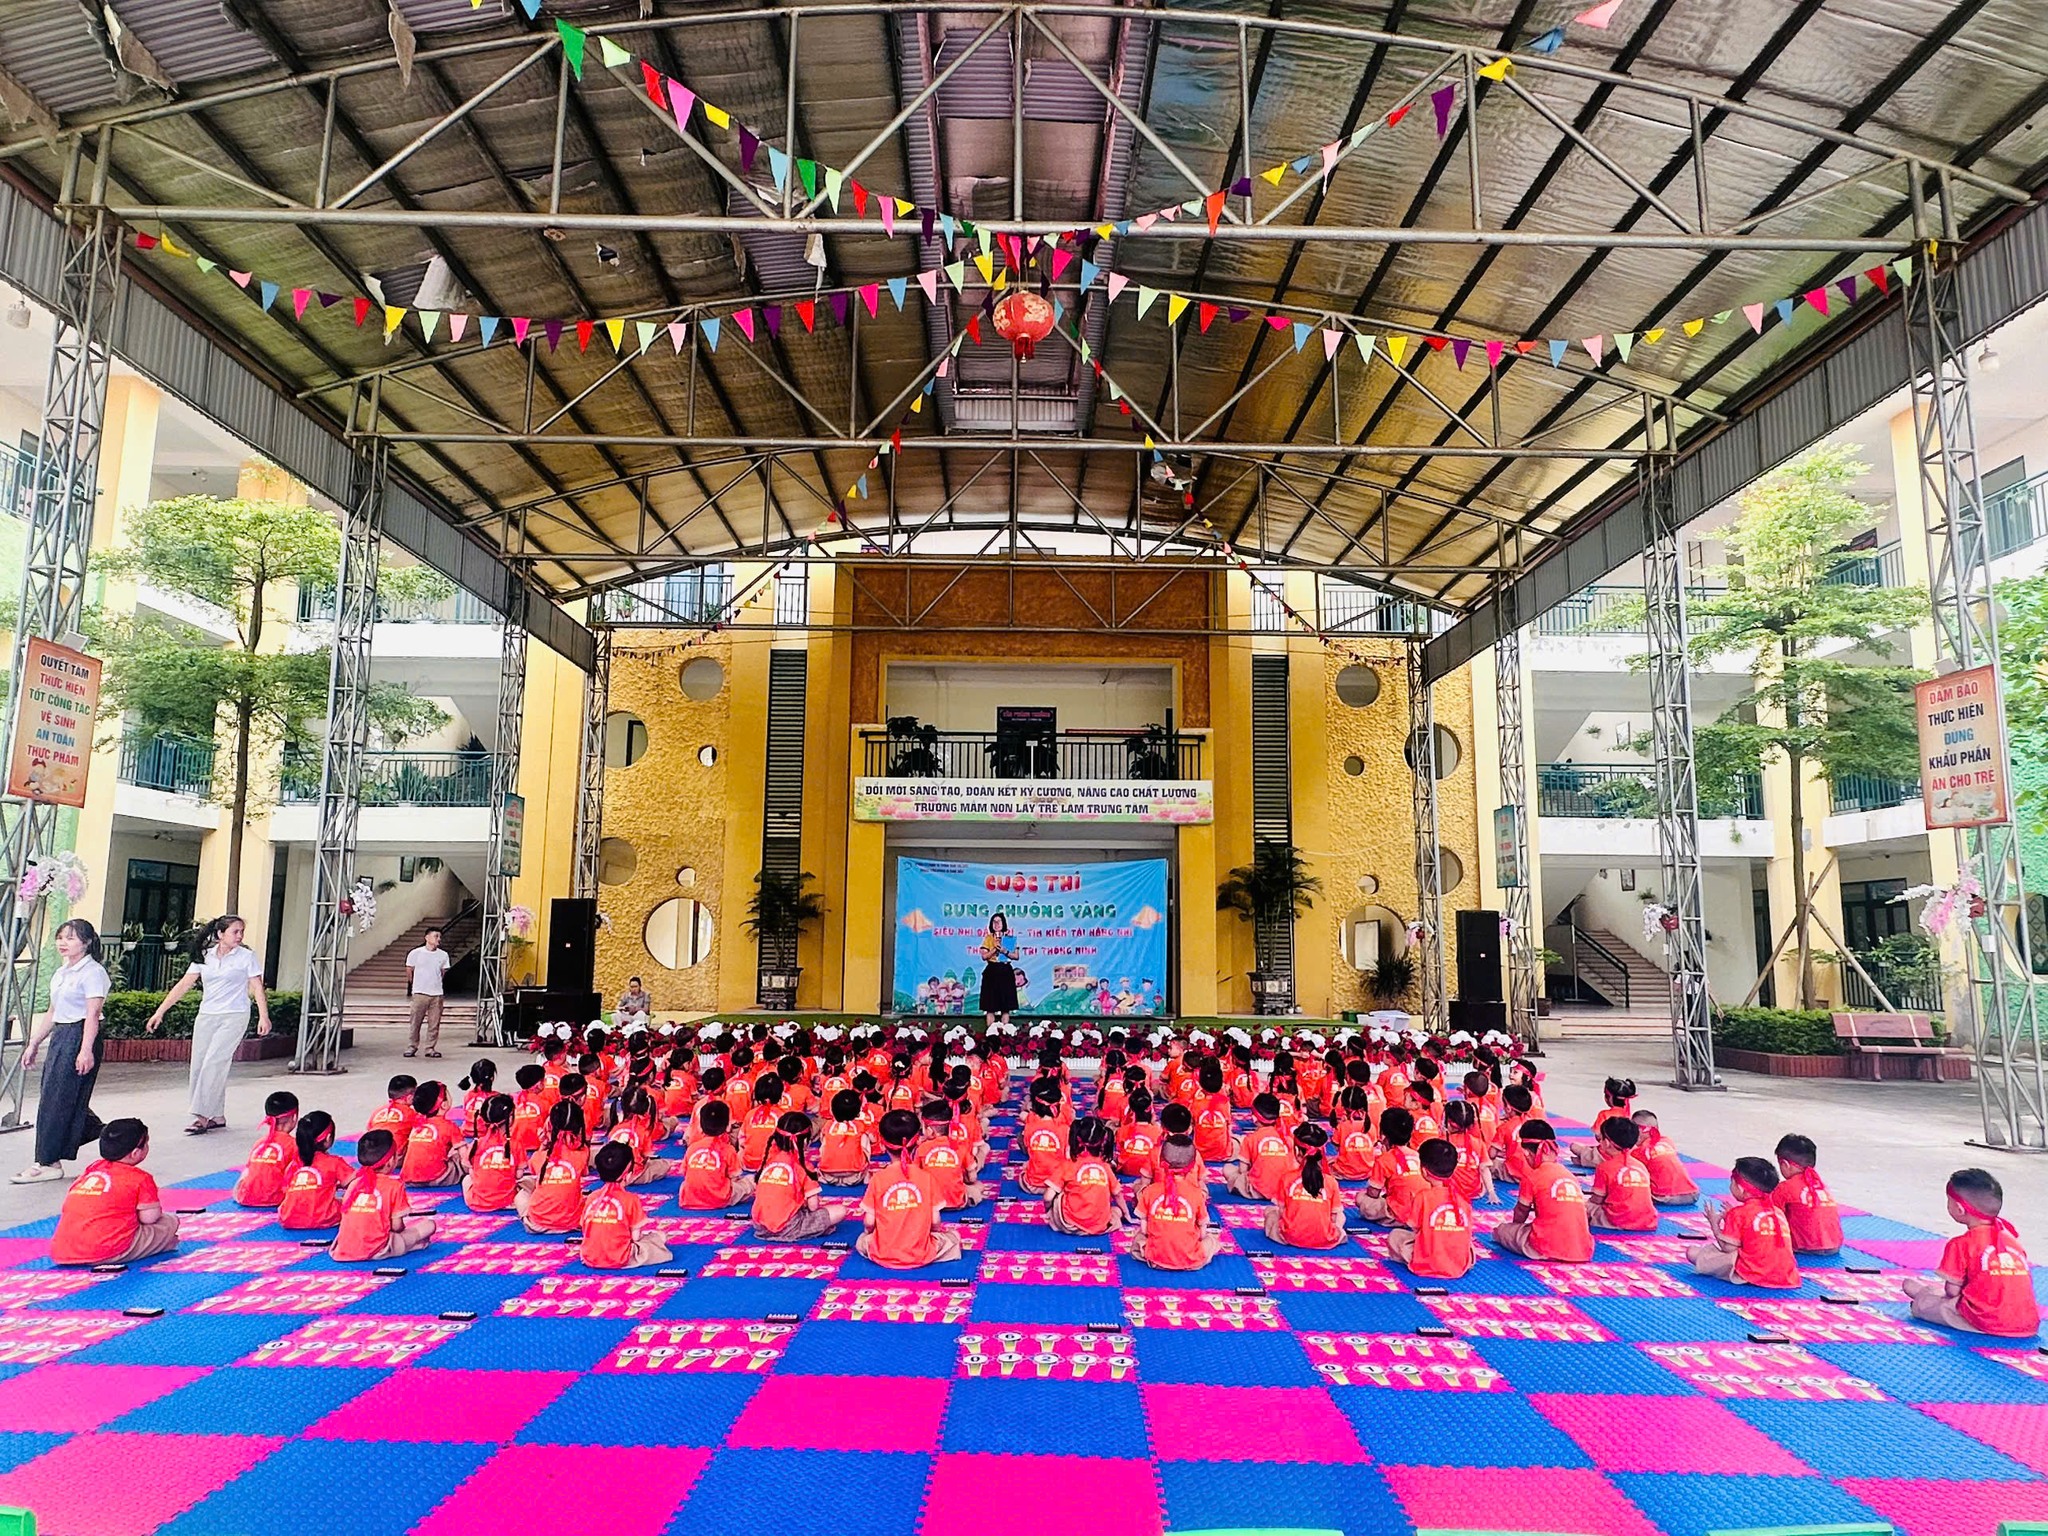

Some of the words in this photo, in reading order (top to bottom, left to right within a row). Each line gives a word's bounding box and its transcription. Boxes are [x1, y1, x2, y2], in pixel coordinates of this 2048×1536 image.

[41, 654, 69, 672] QUYẾT
[72, 664, 89, 680] TÂM
[29, 688, 46, 702] TỐT
[48, 694, 72, 710] CÔNG
[41, 710, 52, 726] VỆ
[54, 715, 76, 729] SINH
[1928, 710, 1954, 726] THỰC
[1958, 702, 1984, 720] HIỆN
[36, 728, 49, 740] AN
[1929, 749, 1957, 769] KHẨU
[1950, 773, 1971, 788] CHO
[1110, 788, 1129, 798] CAO
[990, 803, 1012, 813] NON
[1087, 804, 1122, 813] TRUNG
[986, 871, 1038, 898] CUỘC
[943, 903, 990, 917] RUNG
[996, 901, 1064, 918] CHUÔNG
[1070, 900, 1116, 918] VÀNG
